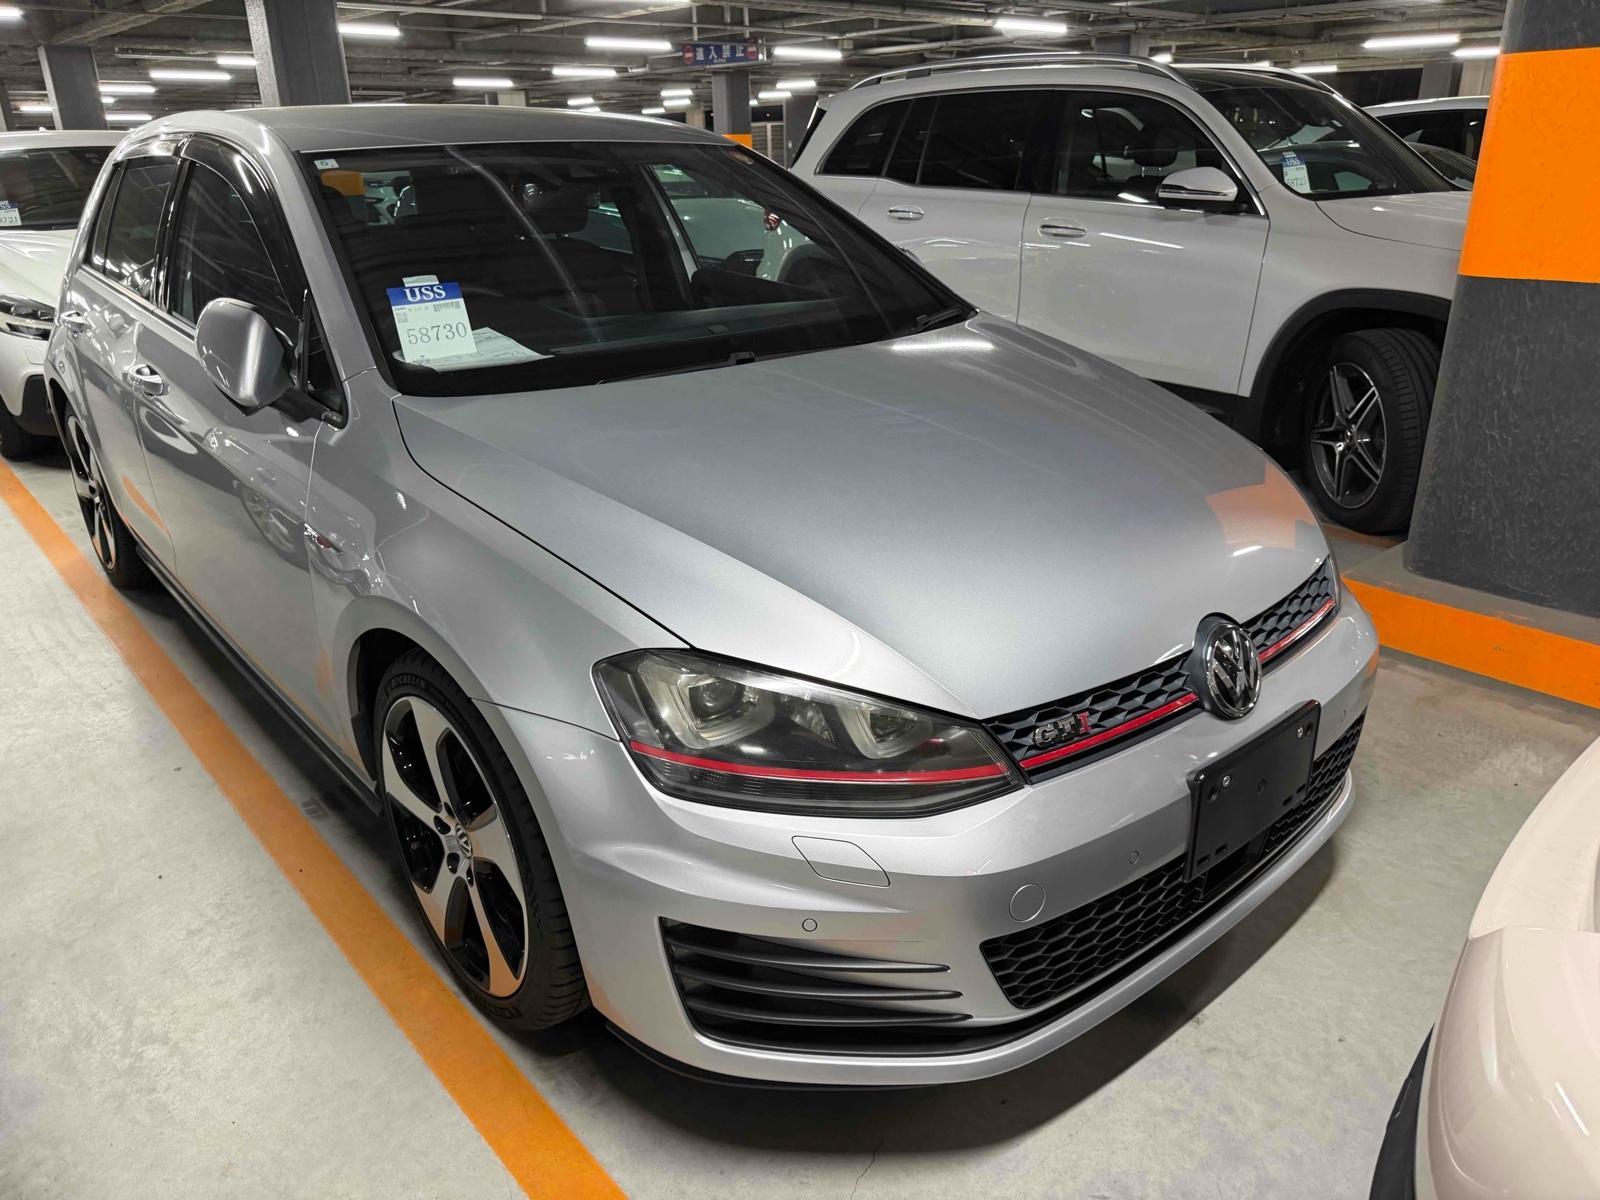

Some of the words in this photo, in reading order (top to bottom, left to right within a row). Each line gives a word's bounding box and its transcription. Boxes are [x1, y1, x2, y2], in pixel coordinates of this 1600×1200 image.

[404, 284, 446, 302] USS
[406, 322, 467, 345] 58730
[1033, 711, 1091, 746] GTI
